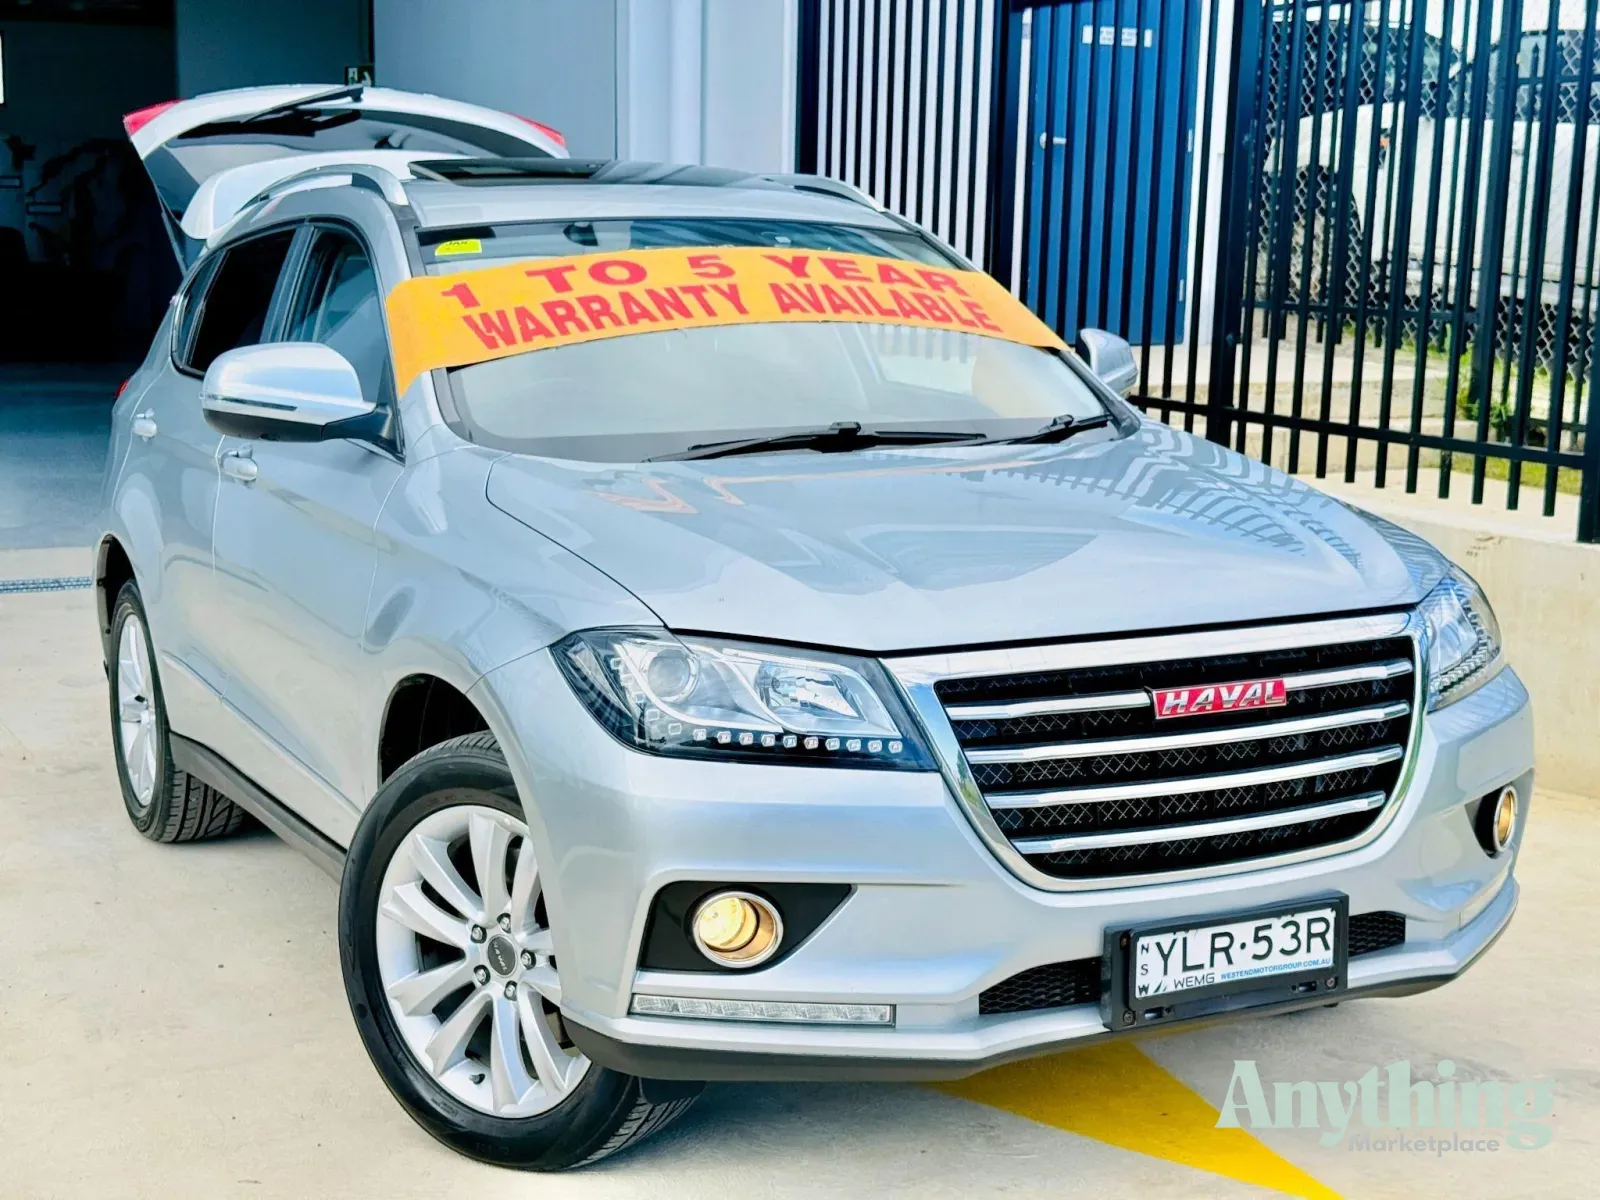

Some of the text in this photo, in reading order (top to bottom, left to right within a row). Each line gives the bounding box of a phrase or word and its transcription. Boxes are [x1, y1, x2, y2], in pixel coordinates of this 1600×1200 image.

[442, 255, 967, 308] 1 TO 5 YEAR
[463, 282, 1004, 350] WARRANTY AVAILABLE
[1162, 682, 1285, 715] HAVAL
[1173, 972, 1215, 990] WEMG
[1220, 958, 1331, 980] WESTENDMOTORGROUP.COM.AU
